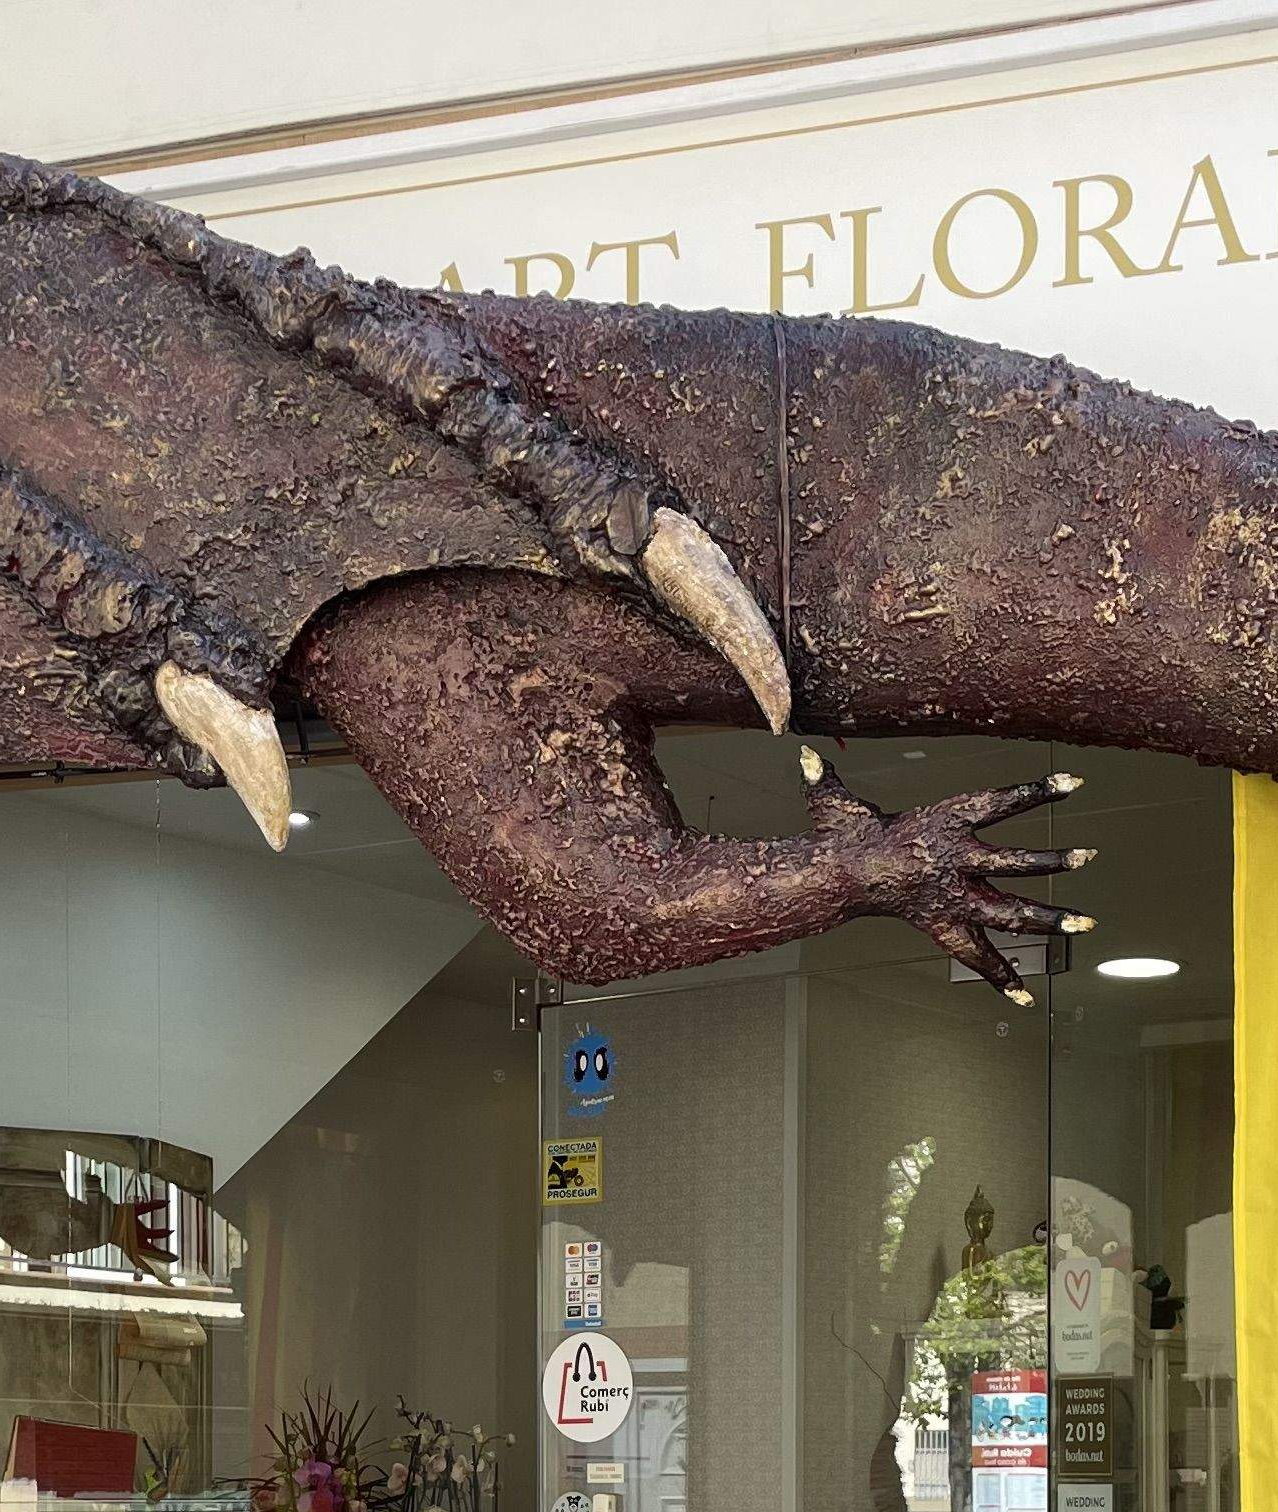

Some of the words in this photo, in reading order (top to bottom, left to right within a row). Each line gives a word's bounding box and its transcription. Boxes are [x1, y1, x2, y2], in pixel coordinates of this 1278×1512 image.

[547, 1142, 597, 1152] CONECTADA
[547, 1187, 597, 1199] PROSEGUR
[580, 1385, 629, 1400] Comerç
[1065, 1388, 1105, 1400] WEDDING
[1065, 1403, 1105, 1415] AWARDS
[1065, 1421, 1106, 1442] 2019
[1065, 1497, 1106, 1508] WEDDING
